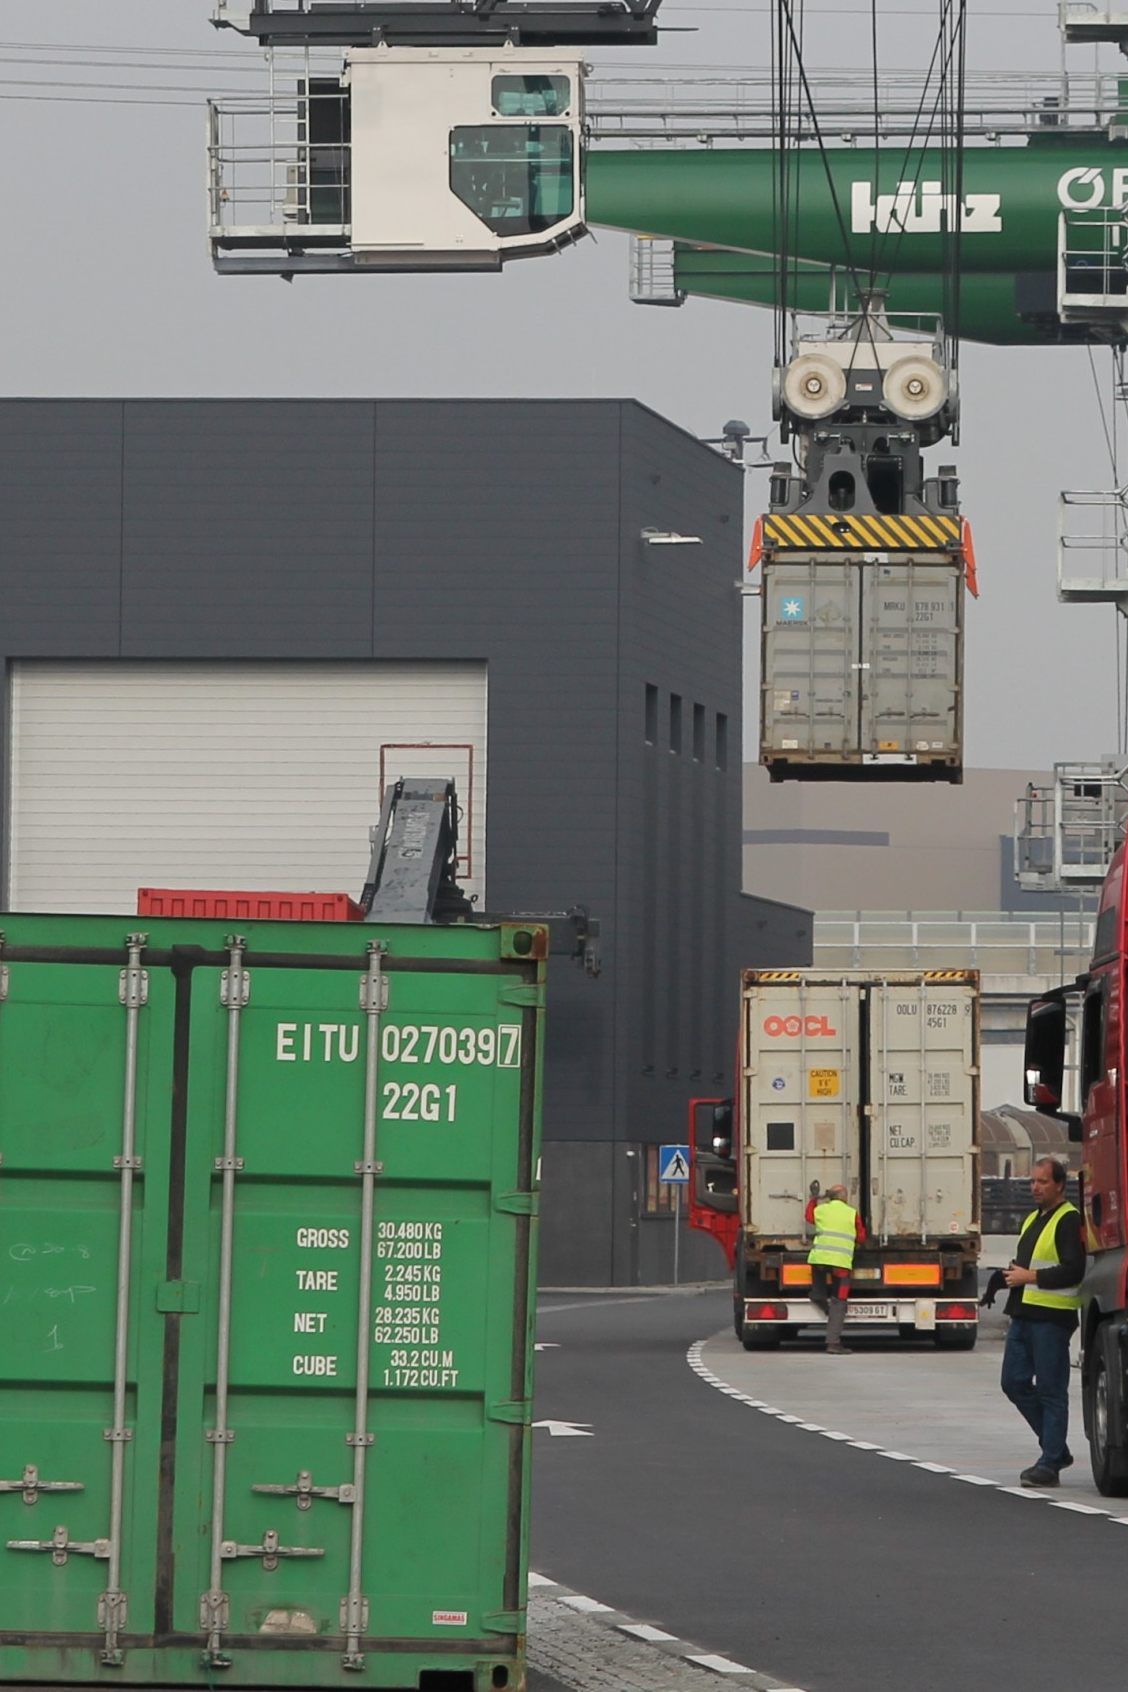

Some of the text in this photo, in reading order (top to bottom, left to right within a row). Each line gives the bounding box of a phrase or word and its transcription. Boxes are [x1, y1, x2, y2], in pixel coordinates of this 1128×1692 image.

[896, 1003, 917, 1016] OOLU
[926, 1003, 957, 1016] 876228
[763, 1015, 837, 1037] OOCL
[926, 1016, 947, 1028] 45G1
[276, 1023, 359, 1062] EITU
[383, 1082, 457, 1122] 22G1
[297, 1228, 350, 1249] GROSS
[296, 1270, 338, 1291] TARE
[294, 1313, 327, 1334] NET
[293, 1355, 337, 1376] CUBE
